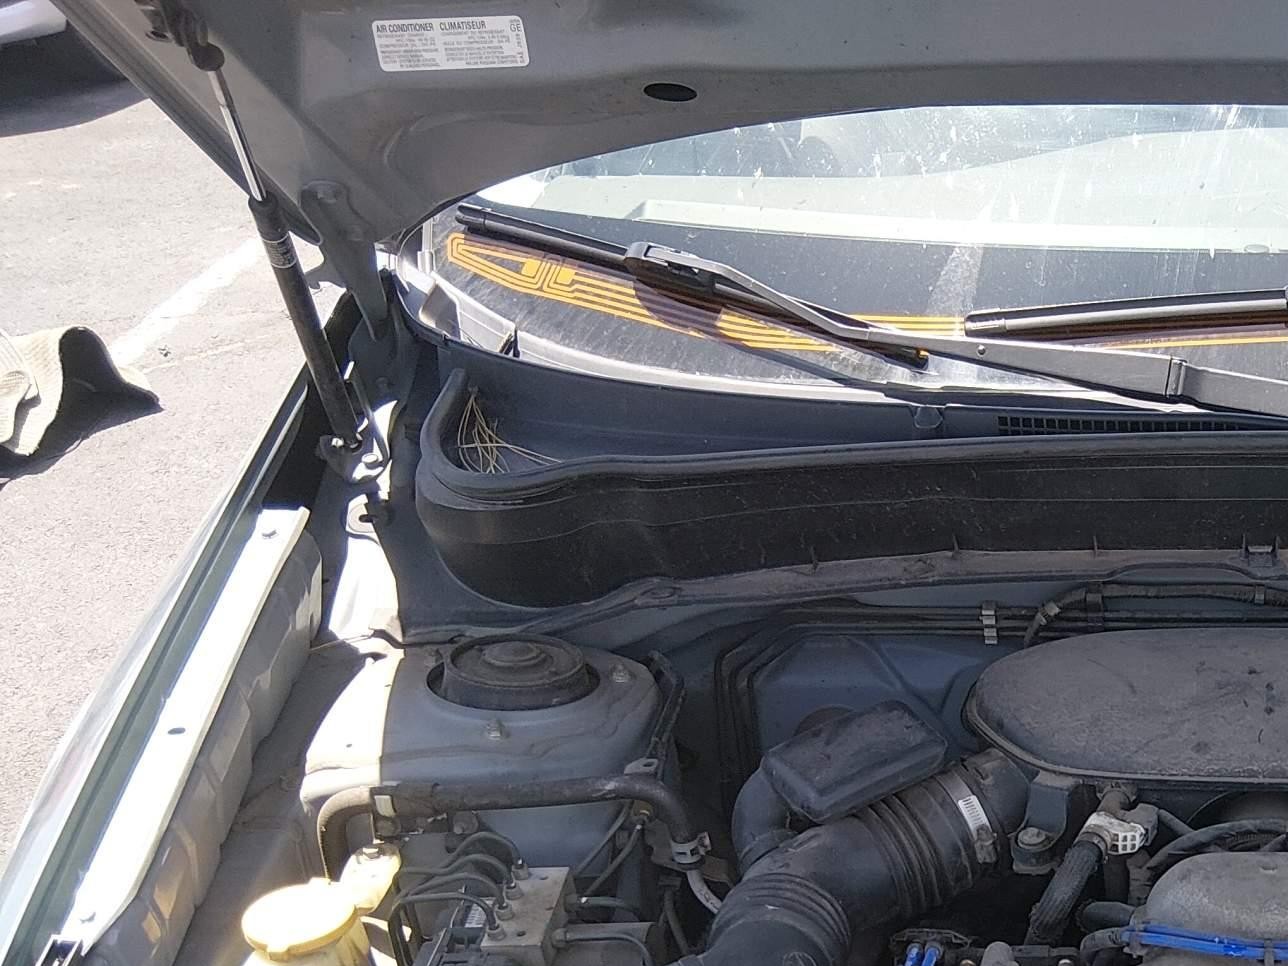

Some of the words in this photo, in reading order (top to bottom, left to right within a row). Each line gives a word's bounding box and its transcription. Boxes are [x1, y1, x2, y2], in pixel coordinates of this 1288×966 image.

[376, 24, 388, 33] AIR
[388, 22, 434, 33] CONDITIONER
[440, 21, 487, 32] CLIMATISEUR
[510, 23, 522, 33] GE
